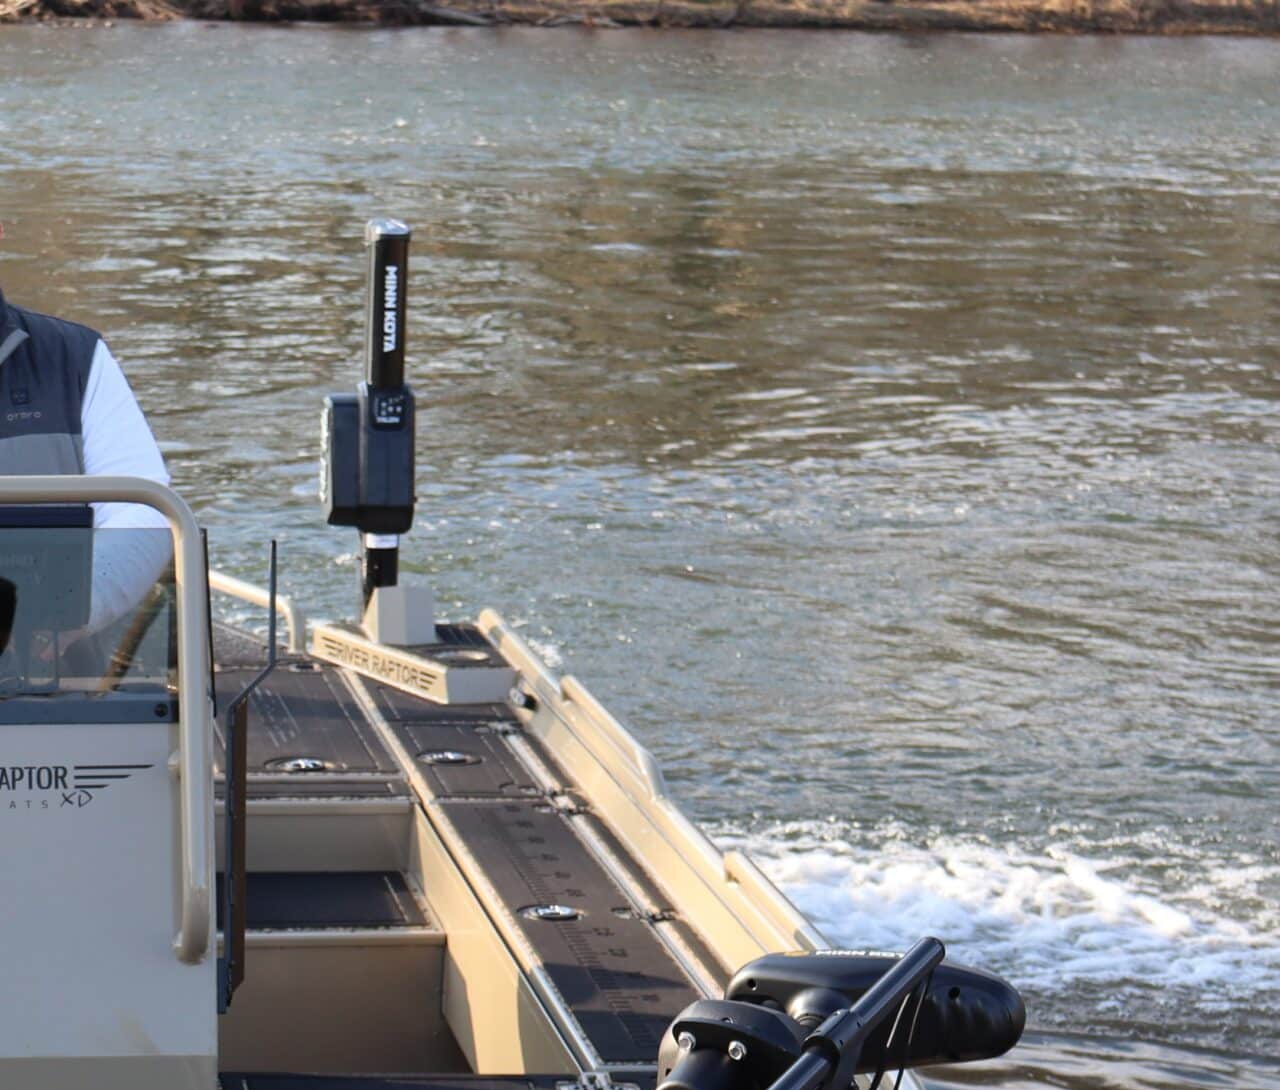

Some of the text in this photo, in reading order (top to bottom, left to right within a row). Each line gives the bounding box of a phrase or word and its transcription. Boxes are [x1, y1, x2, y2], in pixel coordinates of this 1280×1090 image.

[383, 265, 398, 352] MINN KOTA
[339, 643, 419, 687] RIVER RAPTOR
[60, 790, 94, 808] XD
